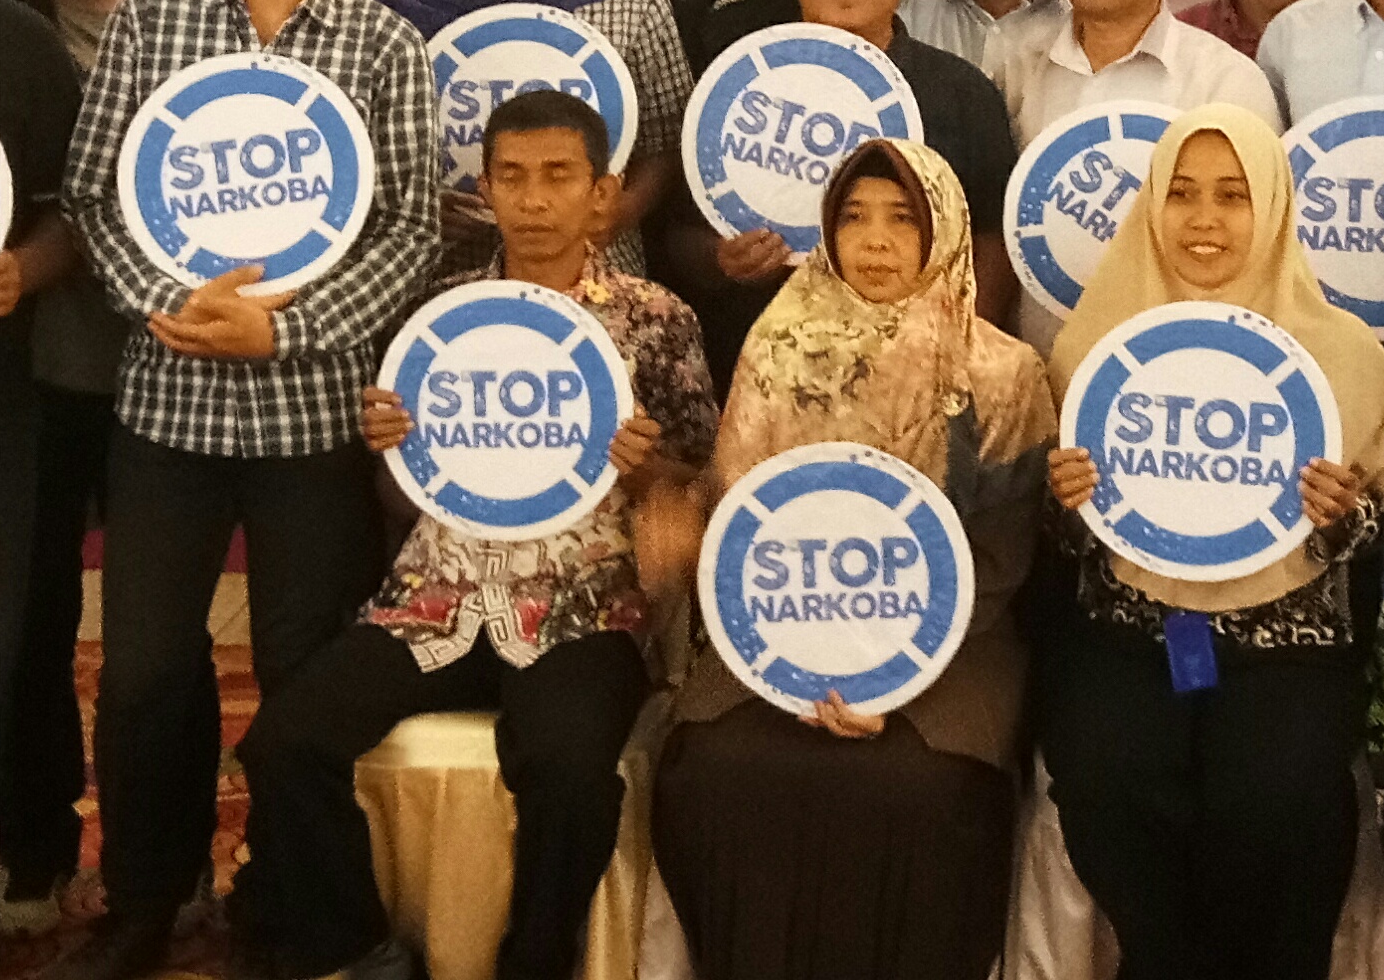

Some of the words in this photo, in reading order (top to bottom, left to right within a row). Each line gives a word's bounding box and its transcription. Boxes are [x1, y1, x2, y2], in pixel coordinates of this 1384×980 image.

[448, 79, 593, 120] STP
[169, 127, 320, 189] STOP
[722, 133, 829, 185] NARKO
[1070, 151, 1142, 211] ST
[169, 173, 330, 218] NARKOBA
[428, 370, 583, 420] STOP
[425, 421, 588, 449] NARKOBA
[1118, 393, 1288, 451] STOP
[1108, 447, 1288, 486] NARKOBA
[753, 536, 921, 591] STOP
[749, 591, 925, 623] NARKOBA
